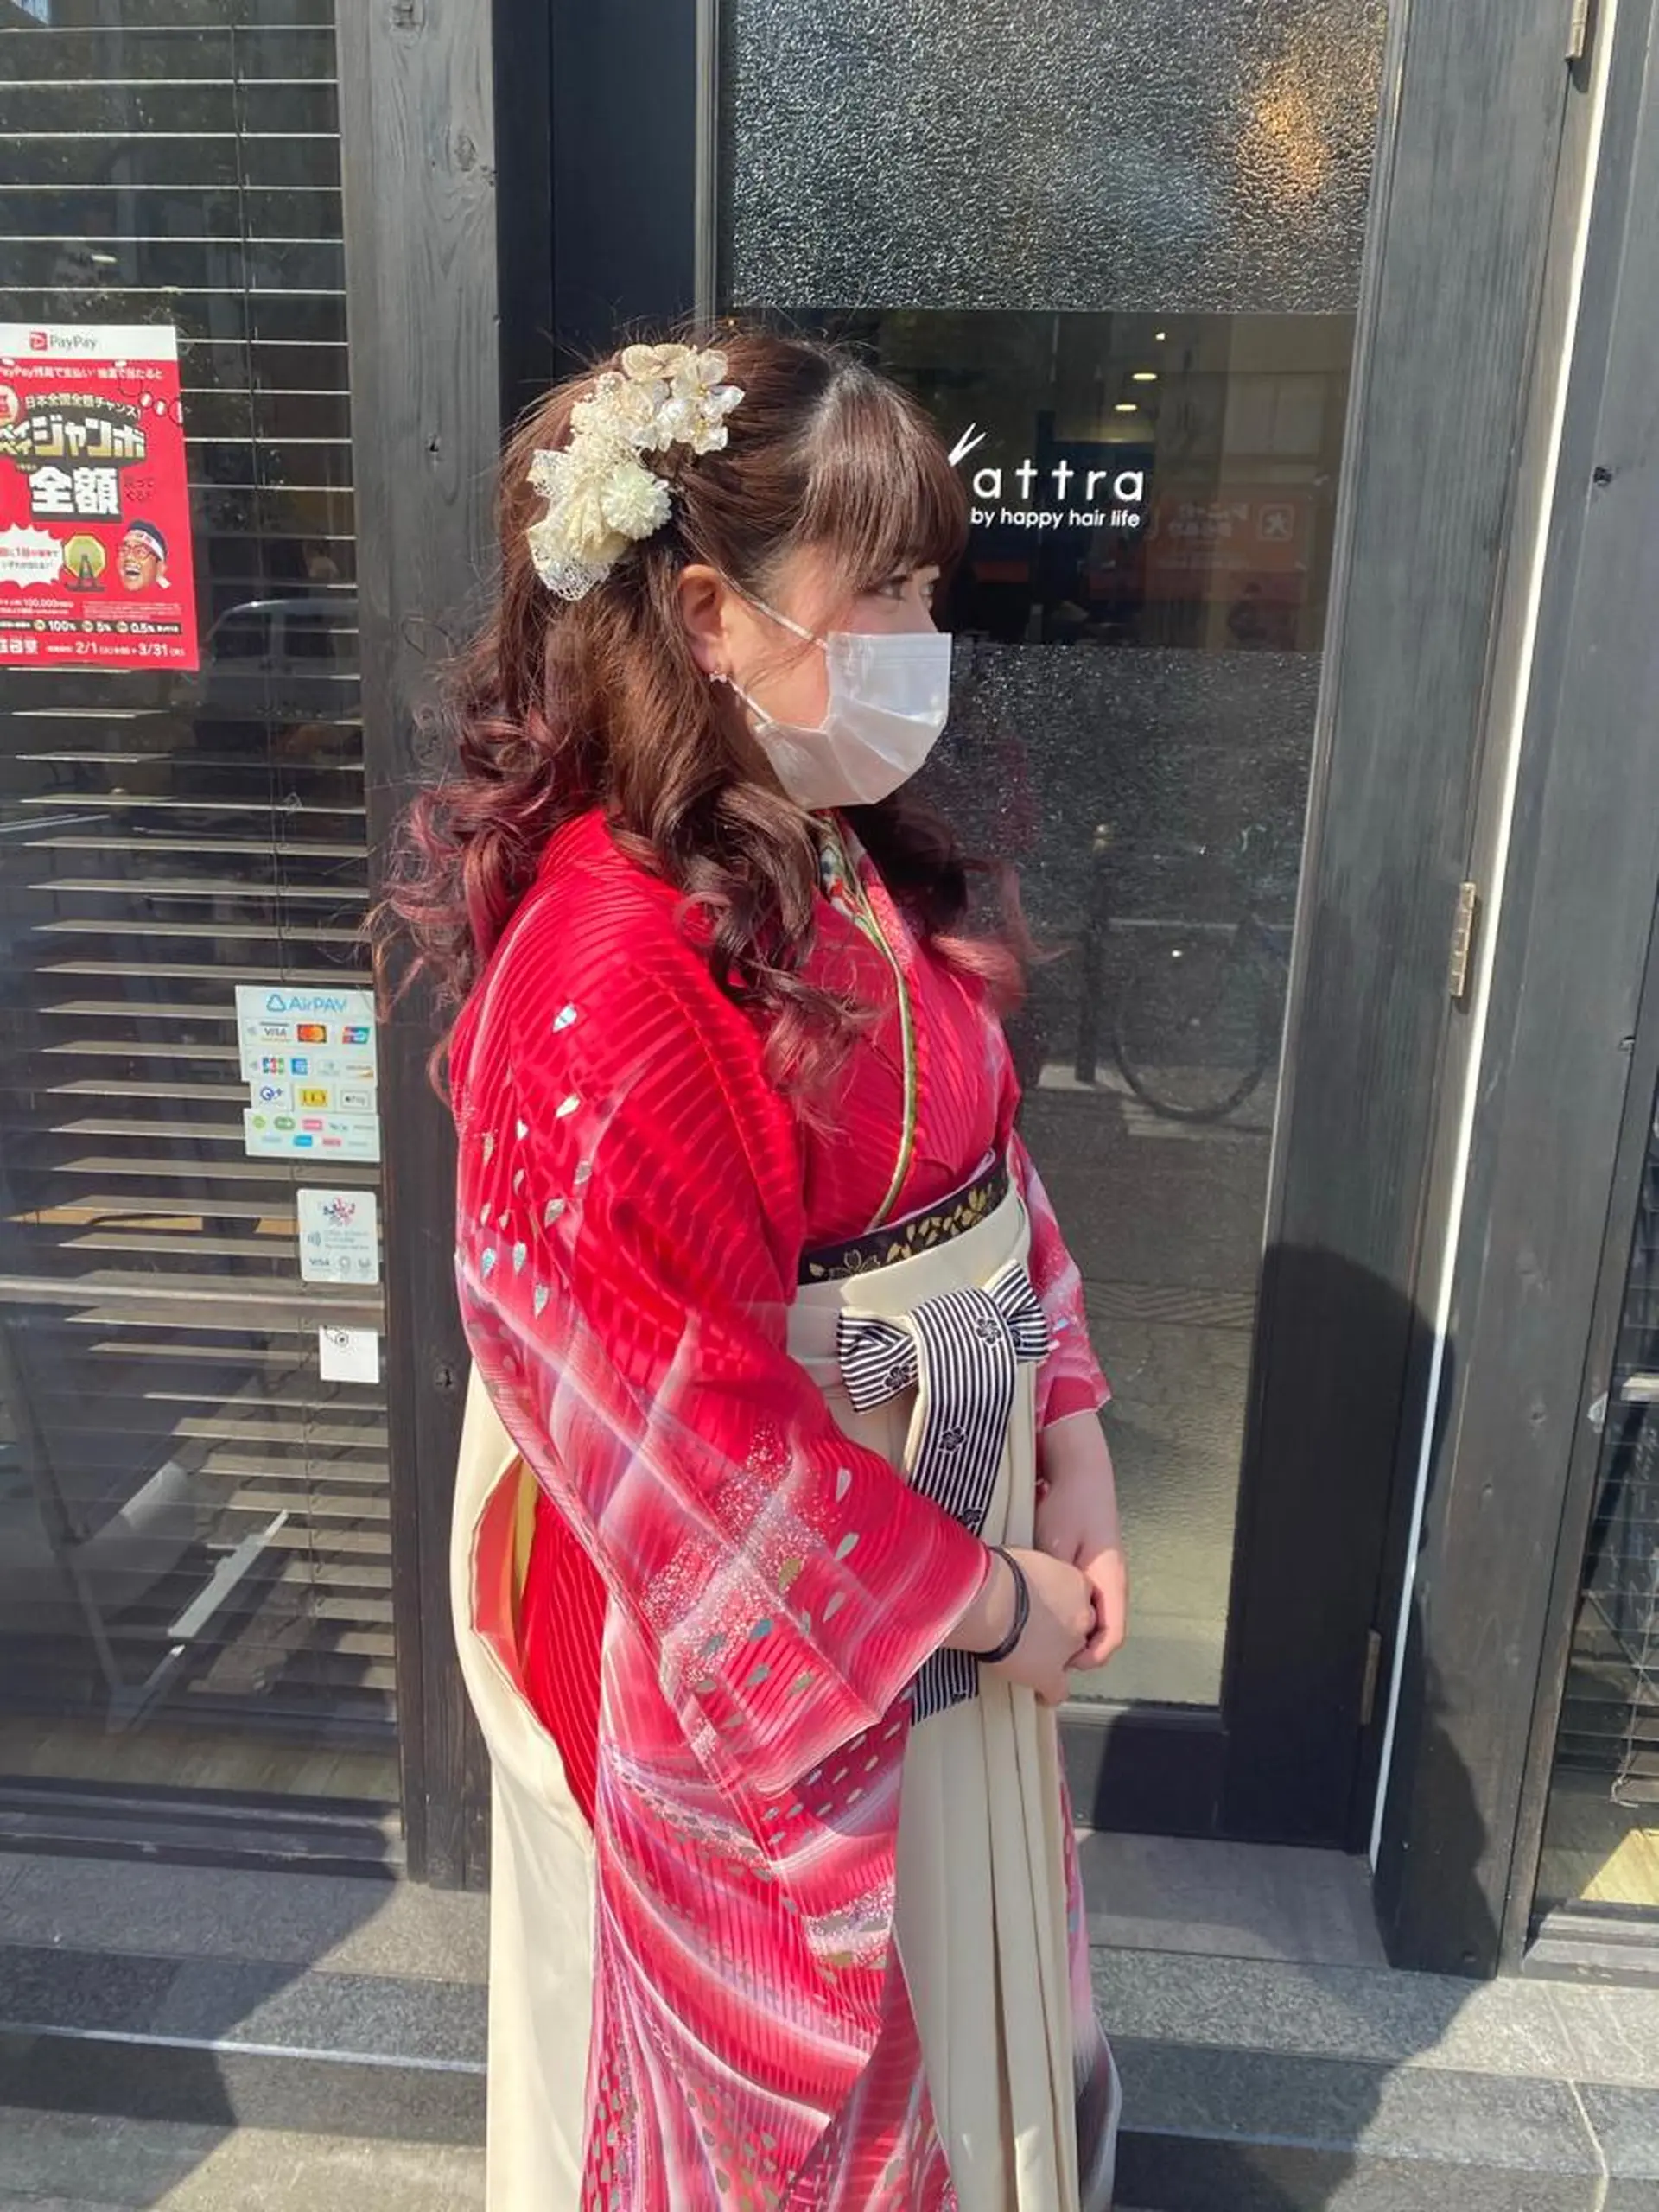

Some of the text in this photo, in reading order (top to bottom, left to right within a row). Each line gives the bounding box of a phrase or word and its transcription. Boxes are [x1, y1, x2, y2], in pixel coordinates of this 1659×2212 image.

[49, 334, 97, 350] PayPay
[29, 467, 120, 514] 全額
[973, 459, 1144, 502] attra
[970, 507, 1141, 530] by happy hair life
